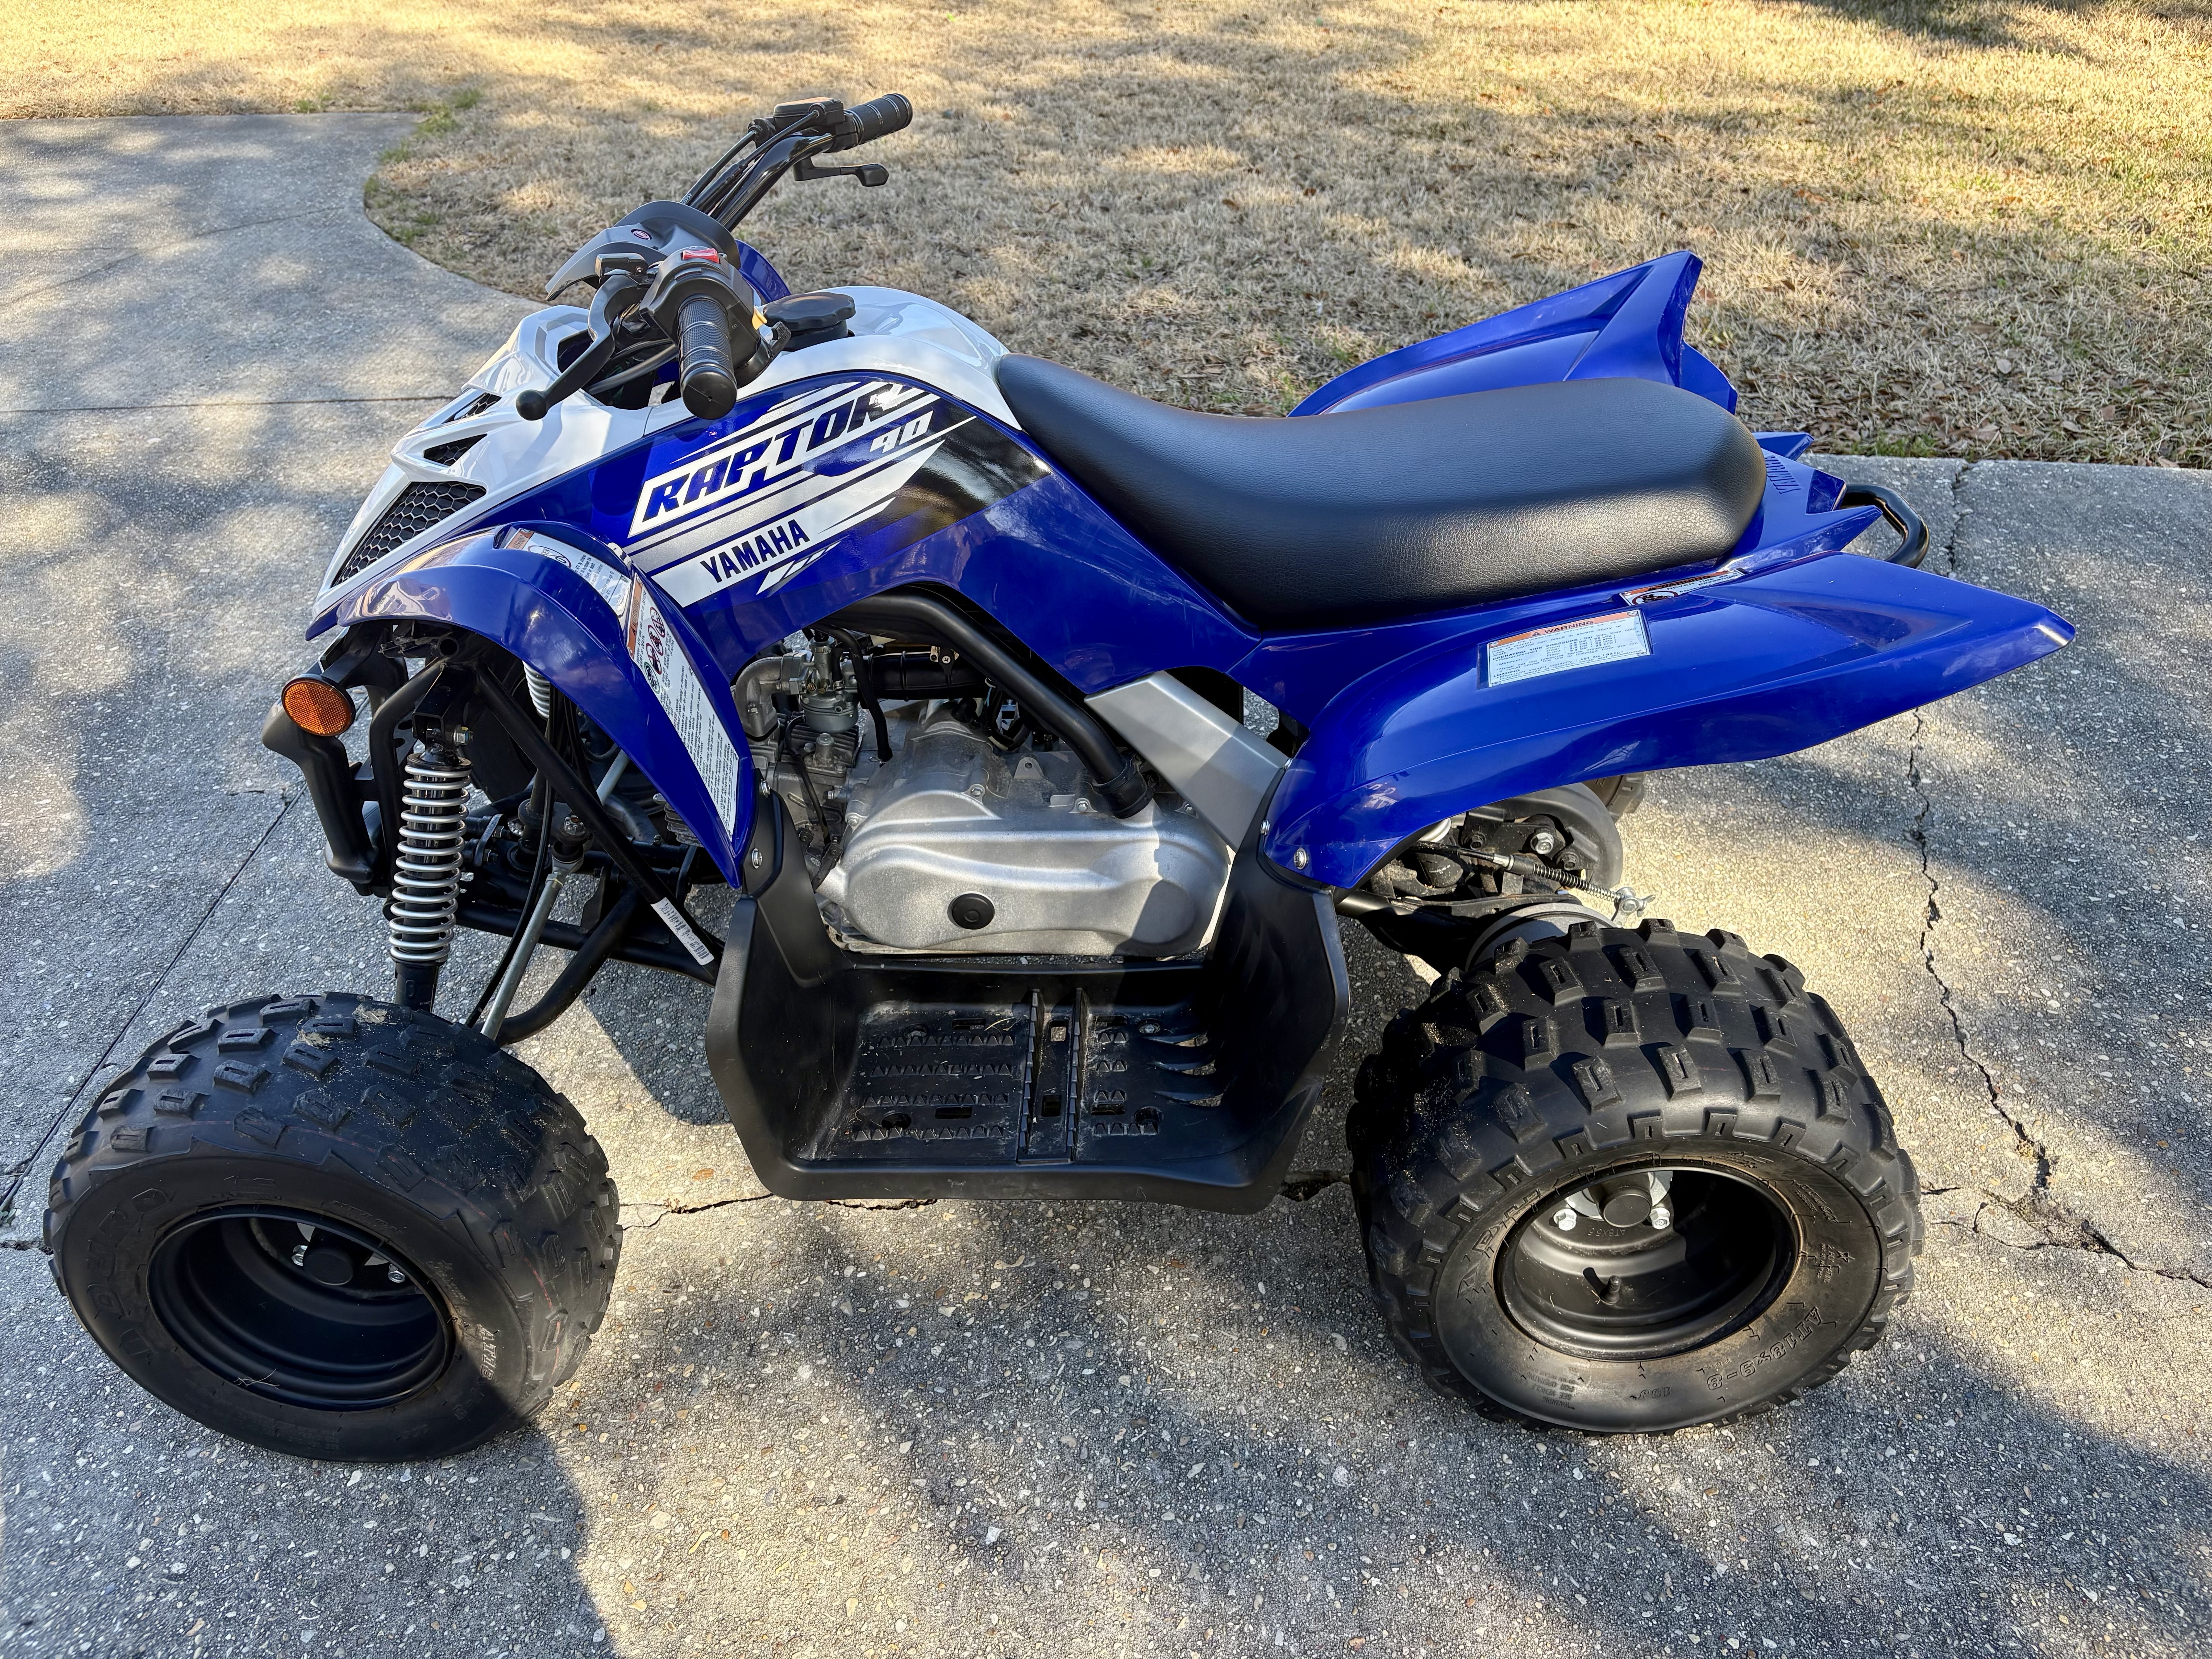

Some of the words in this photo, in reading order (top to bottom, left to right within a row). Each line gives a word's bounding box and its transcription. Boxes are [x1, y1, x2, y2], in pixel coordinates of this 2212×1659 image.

[869, 410, 933, 454] 90
[642, 383, 905, 523] RAPTOR
[700, 519, 811, 583] YAMAHA
[1659, 575, 1711, 588] WARNING
[630, 597, 639, 627] WARNING
[1544, 620, 1593, 634] WARNING
[1492, 650, 1526, 660] OPERATING
[1546, 638, 1578, 647] PRESSURE
[1494, 669, 1520, 677] LOADING
[1707, 1307, 1823, 1391] AT18x9-8
